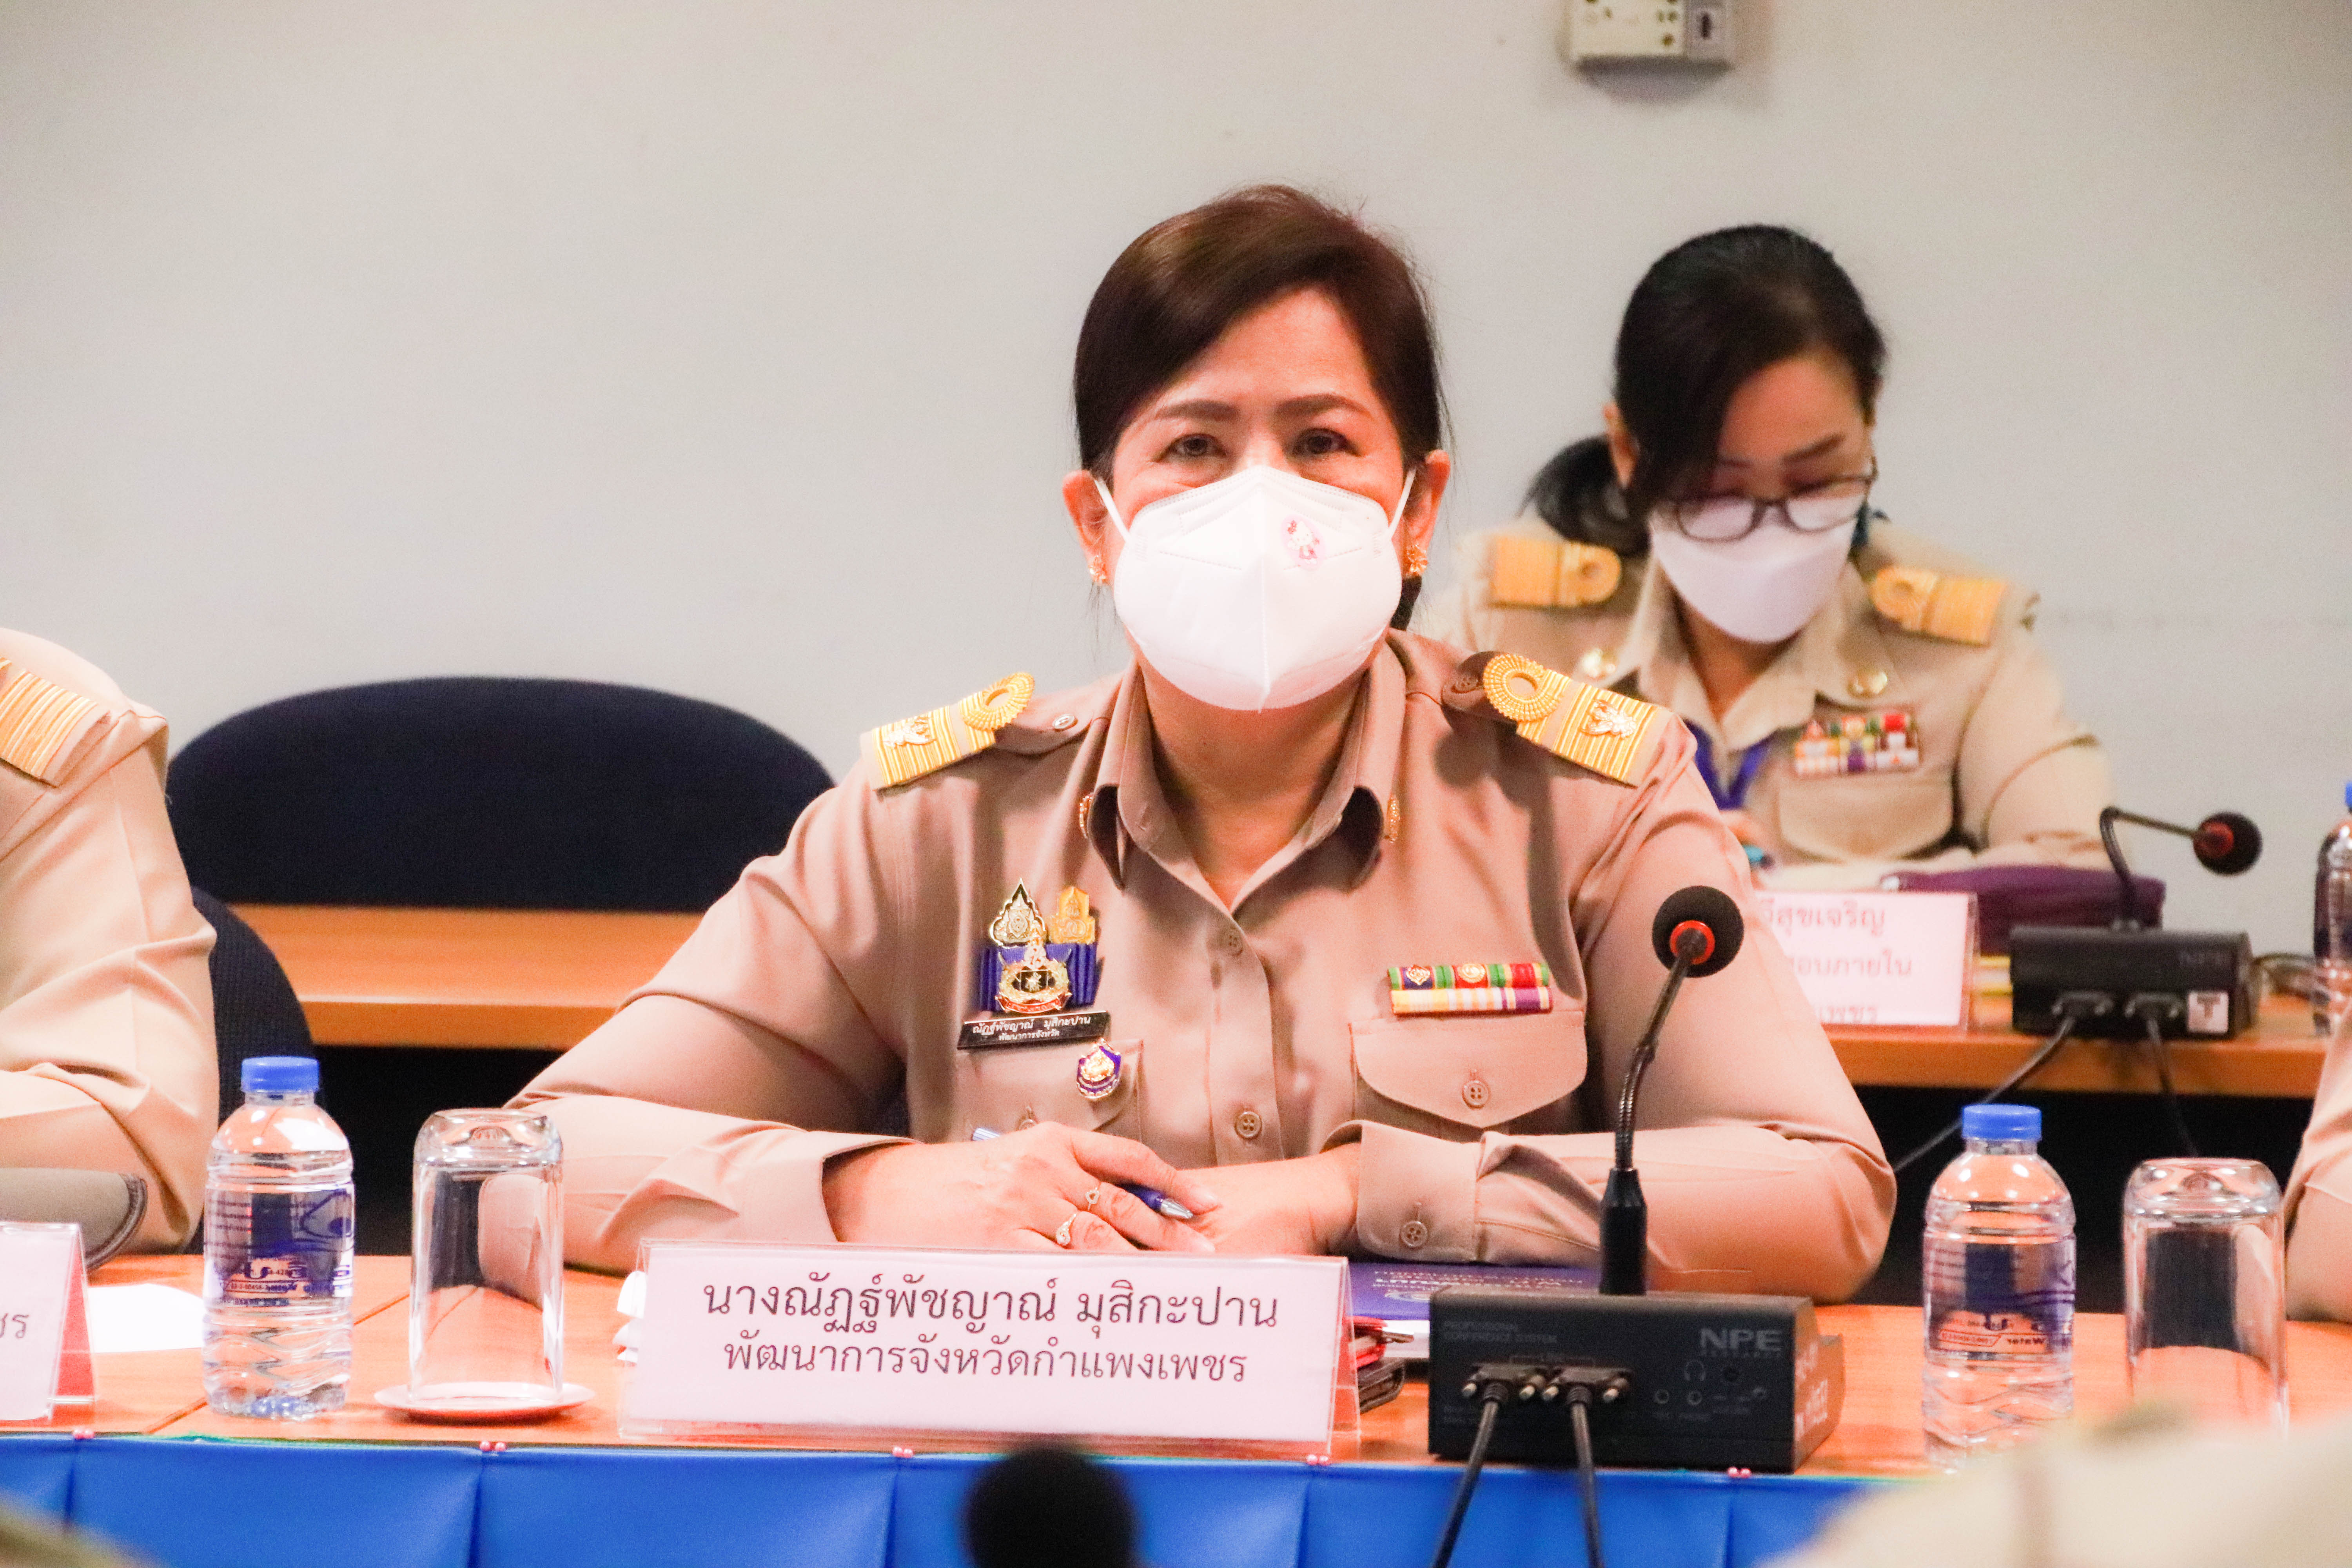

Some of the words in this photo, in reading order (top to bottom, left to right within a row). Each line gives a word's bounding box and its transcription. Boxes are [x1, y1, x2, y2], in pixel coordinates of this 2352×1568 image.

[1791, 947, 1913, 976] อบภายใน
[1077, 1279, 1278, 1339] มุสิกะปาน
[724, 1329, 1248, 1382] พัฒนาการจังหวัดกำแพงเพชร
[1699, 1328, 1783, 1351] NPE
